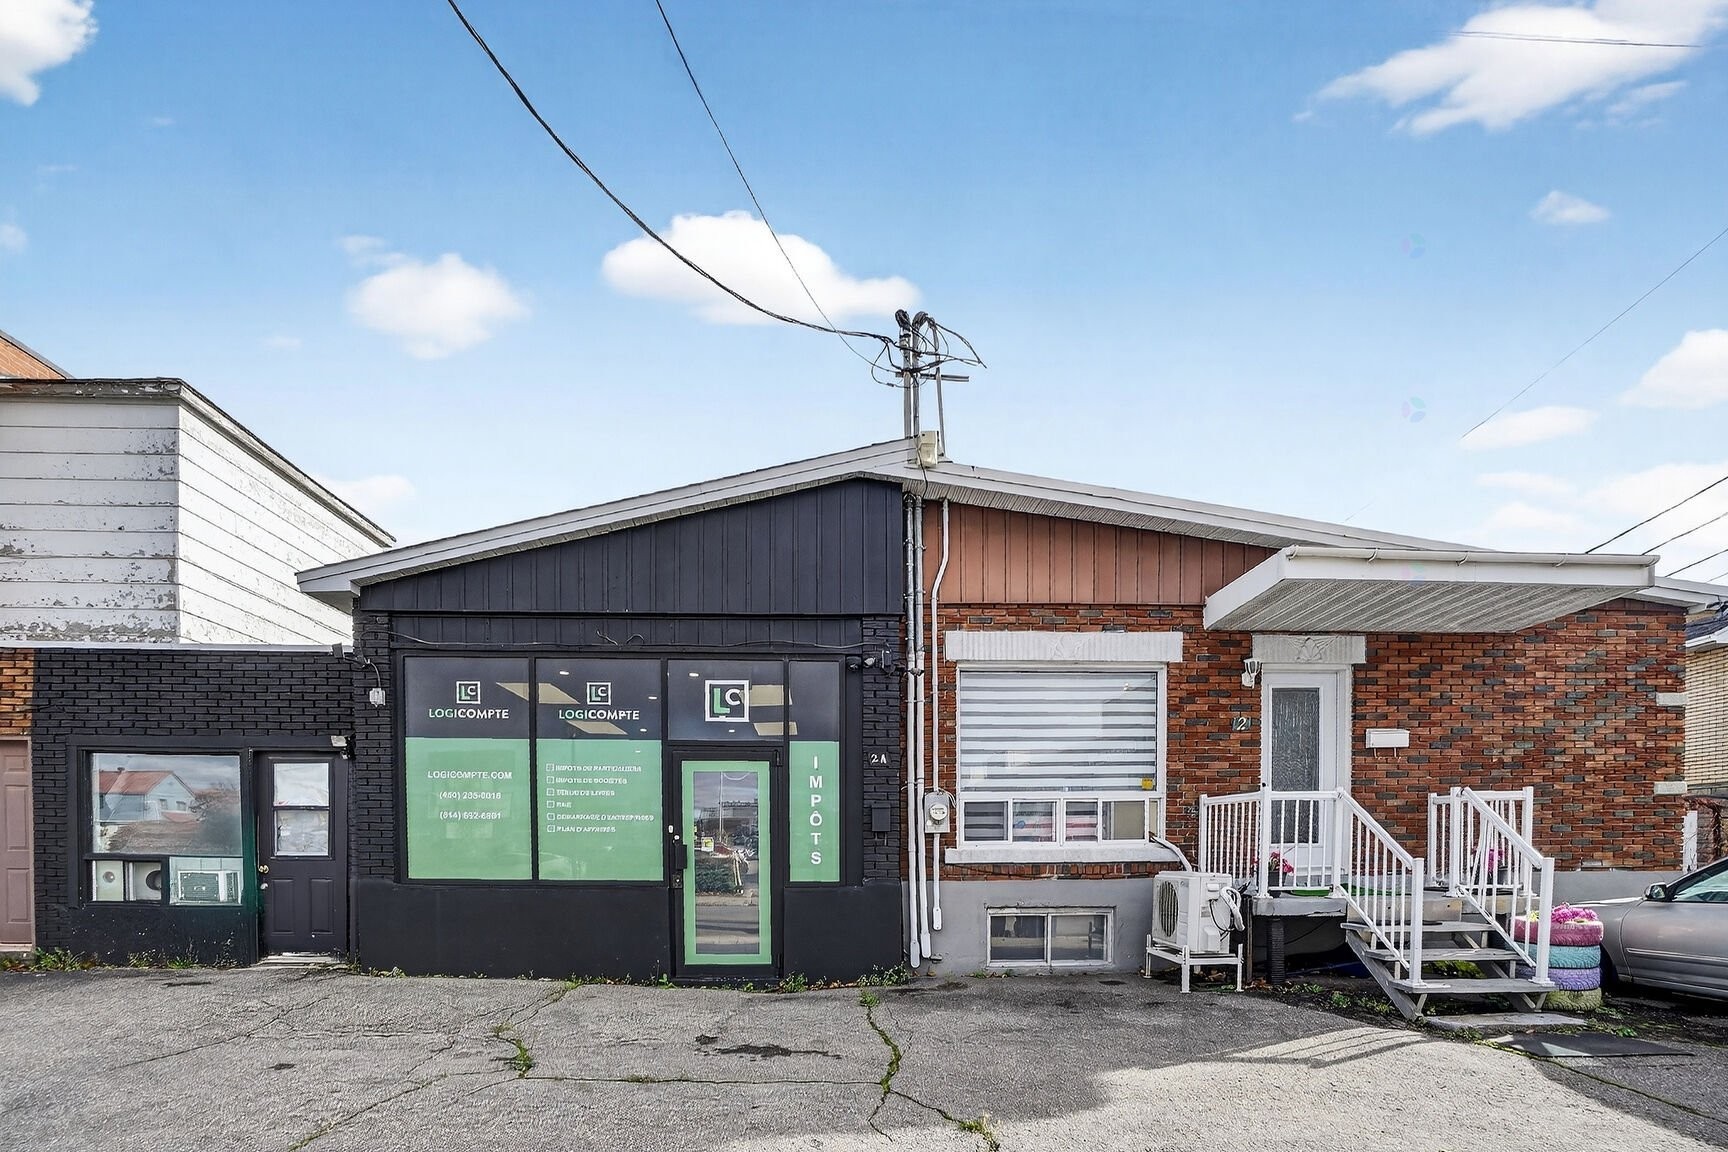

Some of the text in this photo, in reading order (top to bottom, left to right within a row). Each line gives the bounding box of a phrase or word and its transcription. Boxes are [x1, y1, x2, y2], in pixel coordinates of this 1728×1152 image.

[713, 688, 741, 714] LC
[429, 708, 510, 719] LOGICOMPTE
[559, 709, 640, 720] LOGICOMPTE
[1236, 716, 1247, 730] 2
[427, 770, 513, 779] LOGICOMPTE.COM
[809, 755, 823, 865] IMPÔTS
